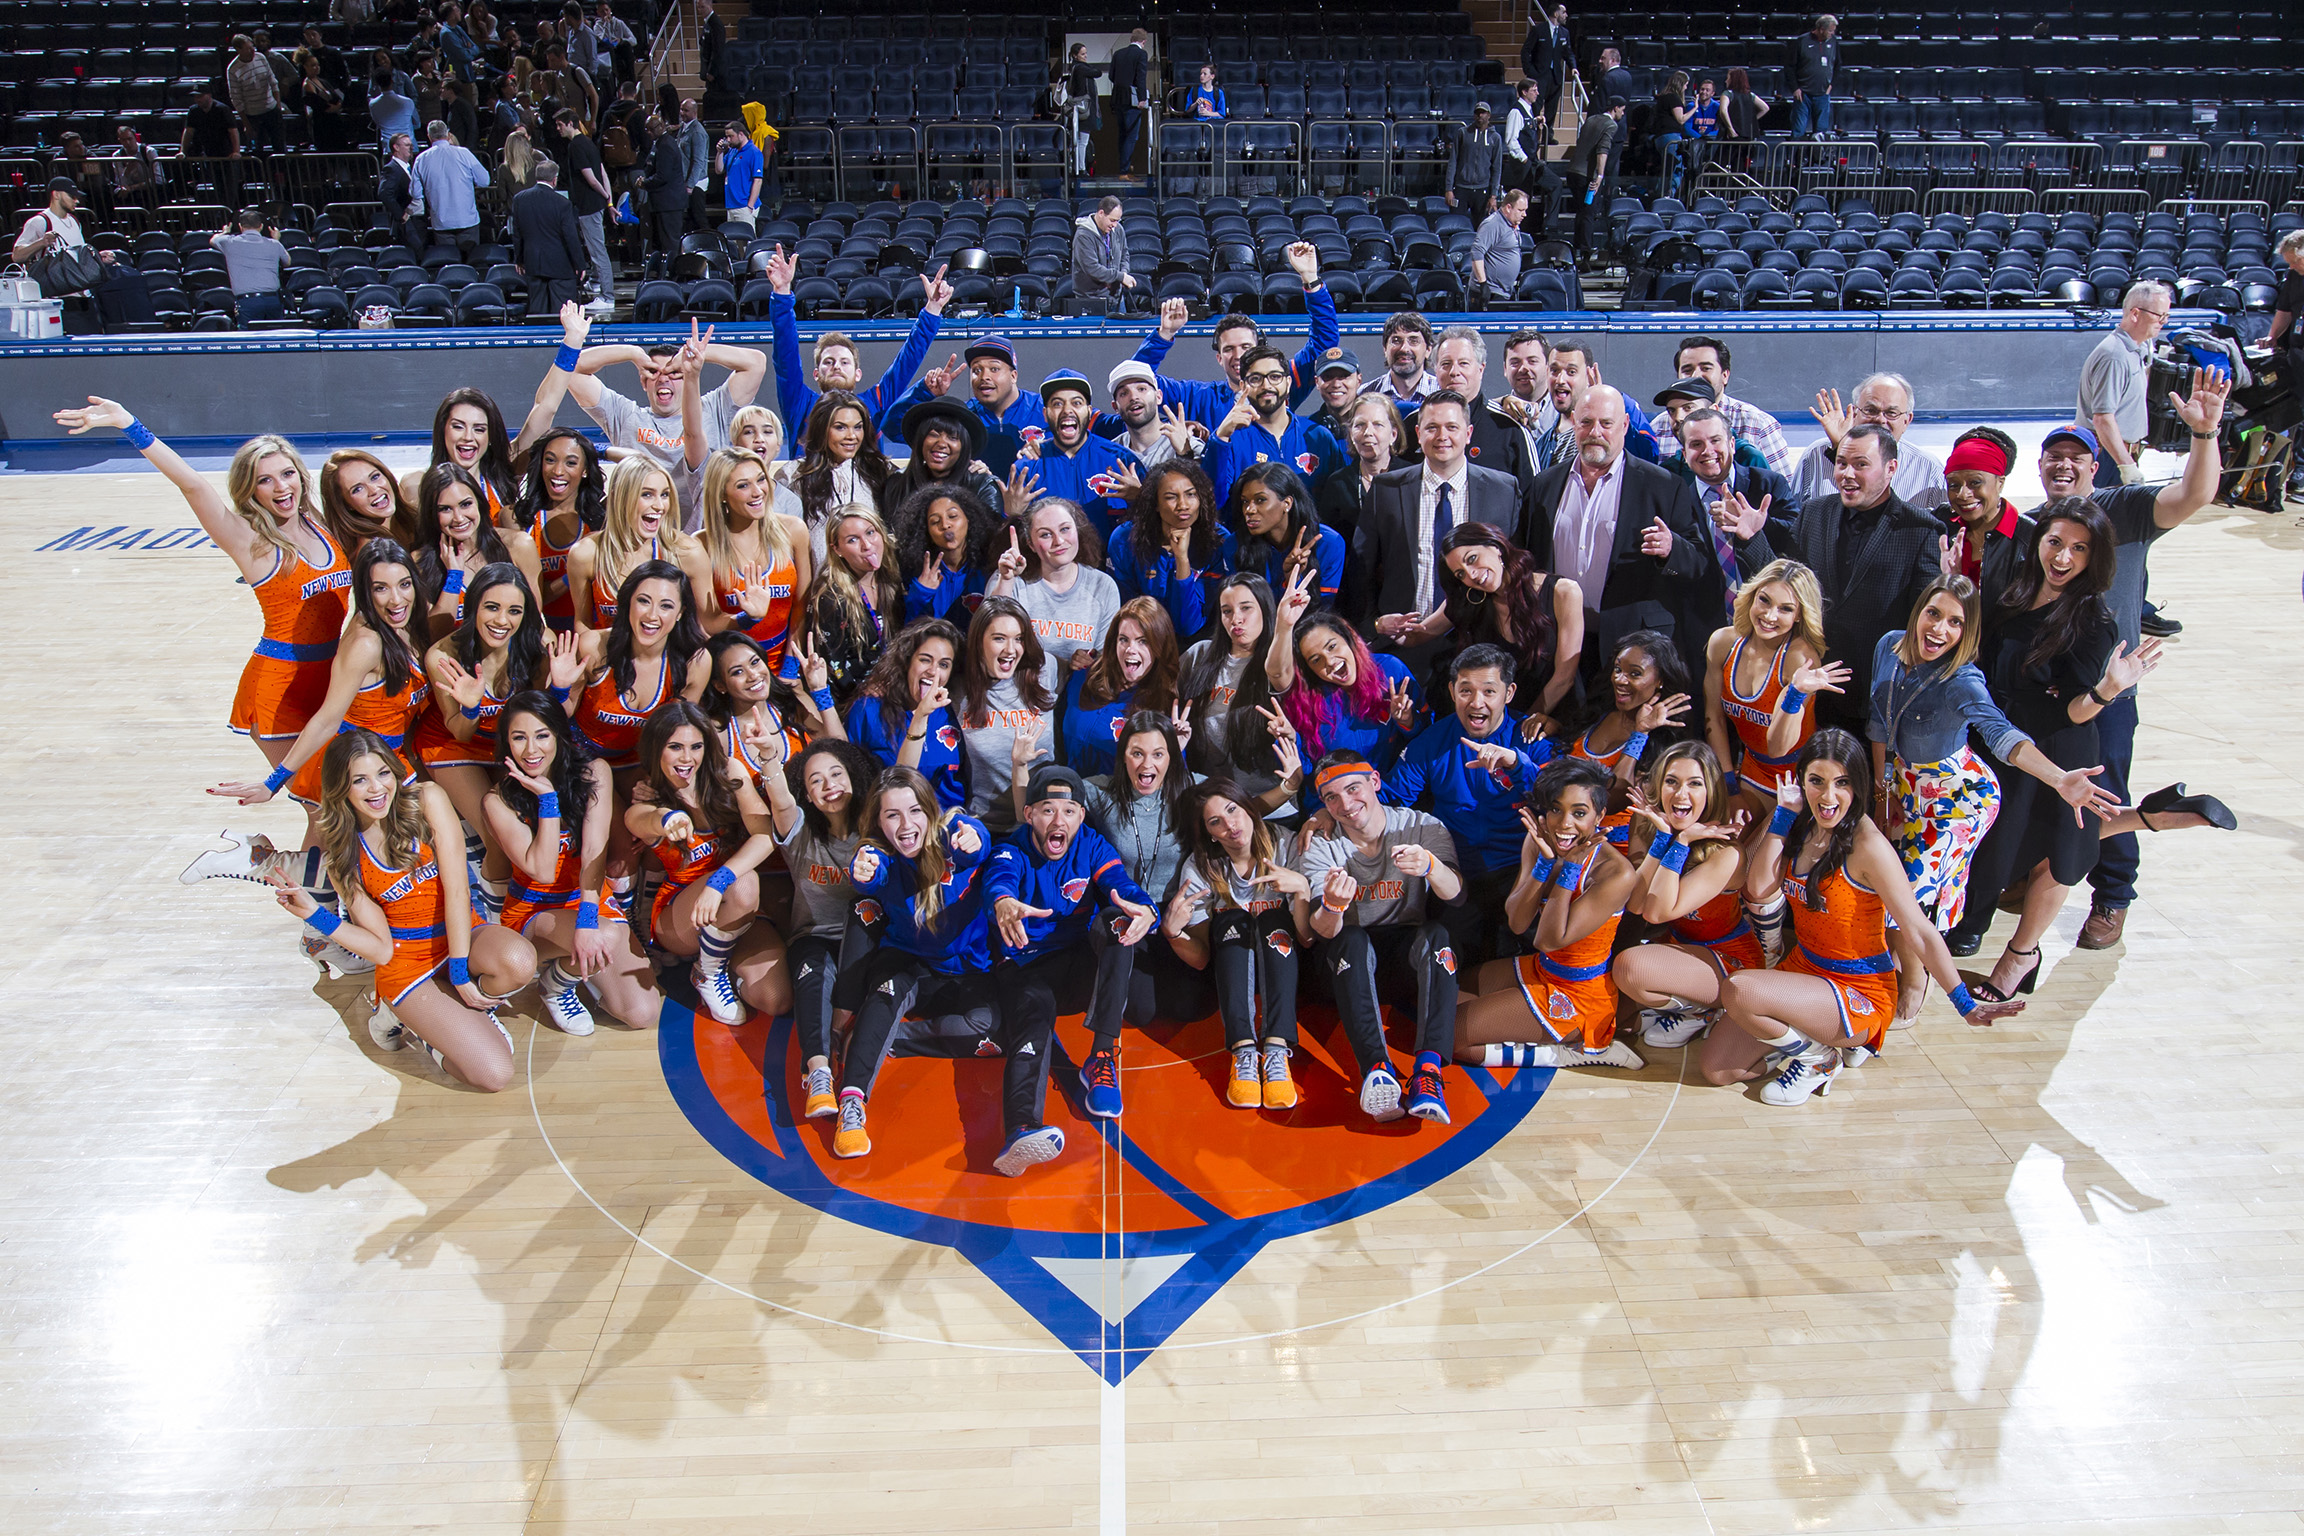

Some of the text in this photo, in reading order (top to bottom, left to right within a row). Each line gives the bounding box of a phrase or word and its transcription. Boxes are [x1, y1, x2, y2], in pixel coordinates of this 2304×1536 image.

[2150, 147, 2164, 156] 106
[33, 526, 221, 552] MADI
[300, 578, 328, 600] NEW
[1054, 620, 1094, 642] YORK
[596, 710, 631, 726] NEW
[808, 864, 843, 886] NEW
[380, 875, 414, 903] NEW
[1368, 880, 1405, 902] YORK
